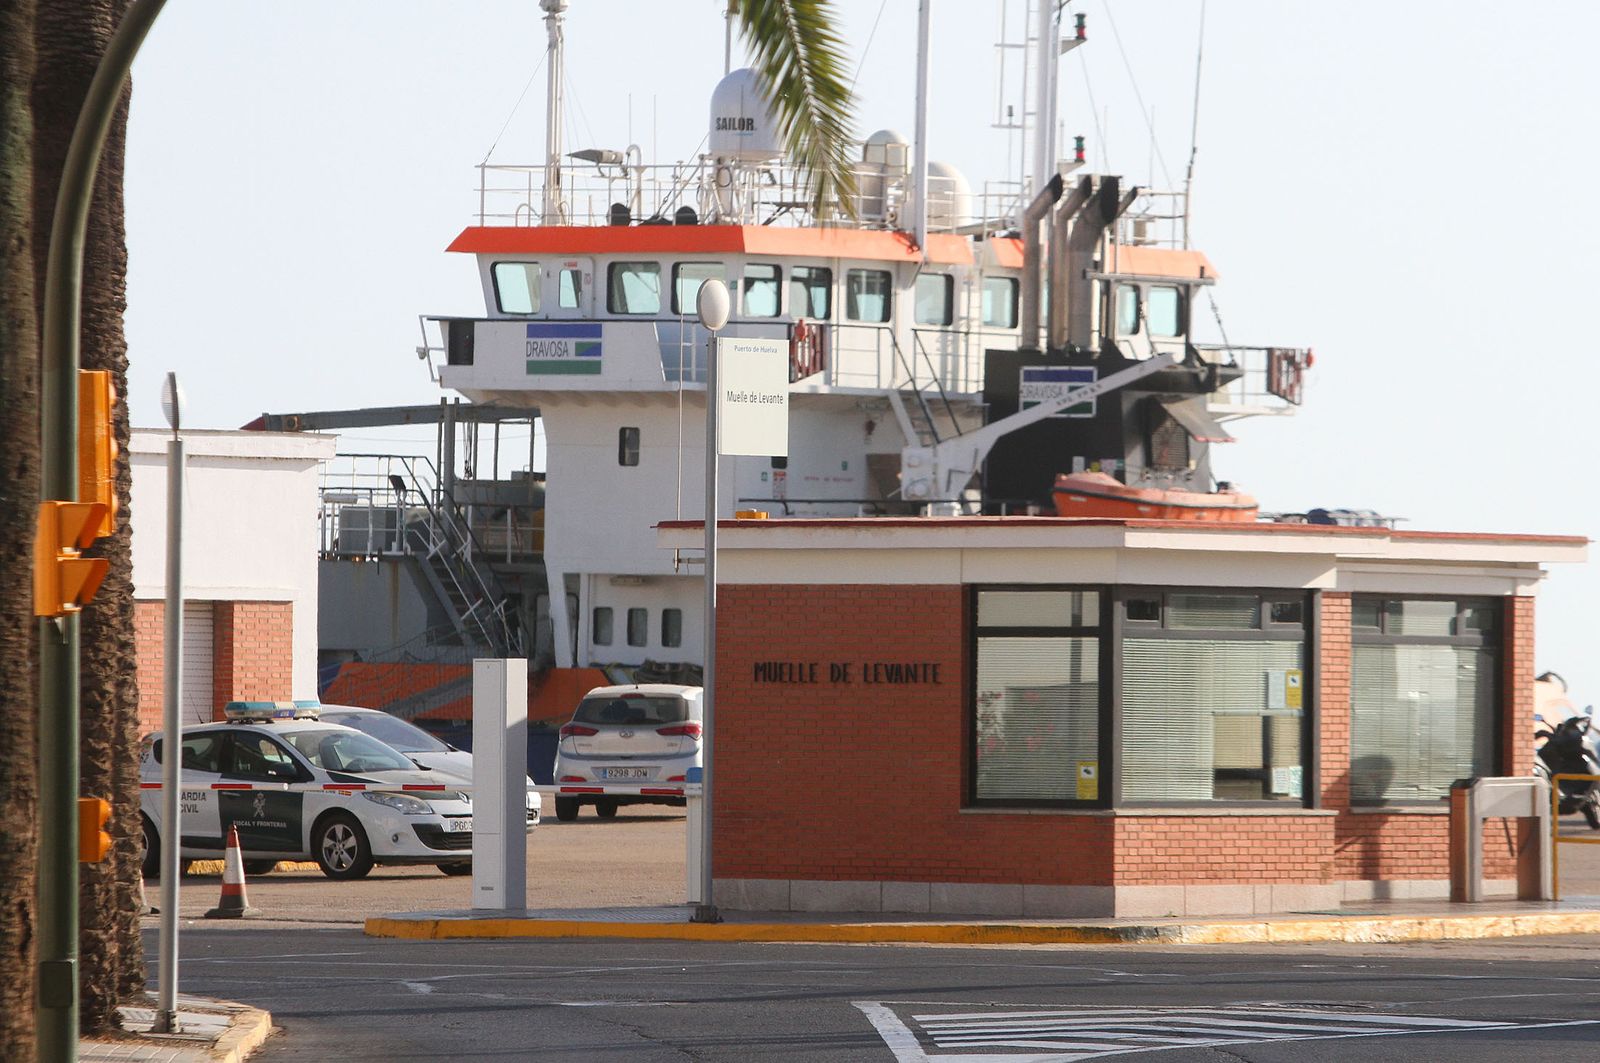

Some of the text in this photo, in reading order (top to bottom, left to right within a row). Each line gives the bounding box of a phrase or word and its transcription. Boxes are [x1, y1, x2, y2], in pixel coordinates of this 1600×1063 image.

[716, 117, 754, 131] SAILOR
[526, 340, 569, 358] DRAVOSA
[734, 345, 752, 353] Puerto
[760, 346, 778, 354] Huelva
[727, 390, 784, 405] Muelle de Levante
[754, 661, 942, 685] MUELLE DE LEVANTE
[180, 791, 207, 802] ARDIA
[256, 820, 287, 829] FRONTERAS
